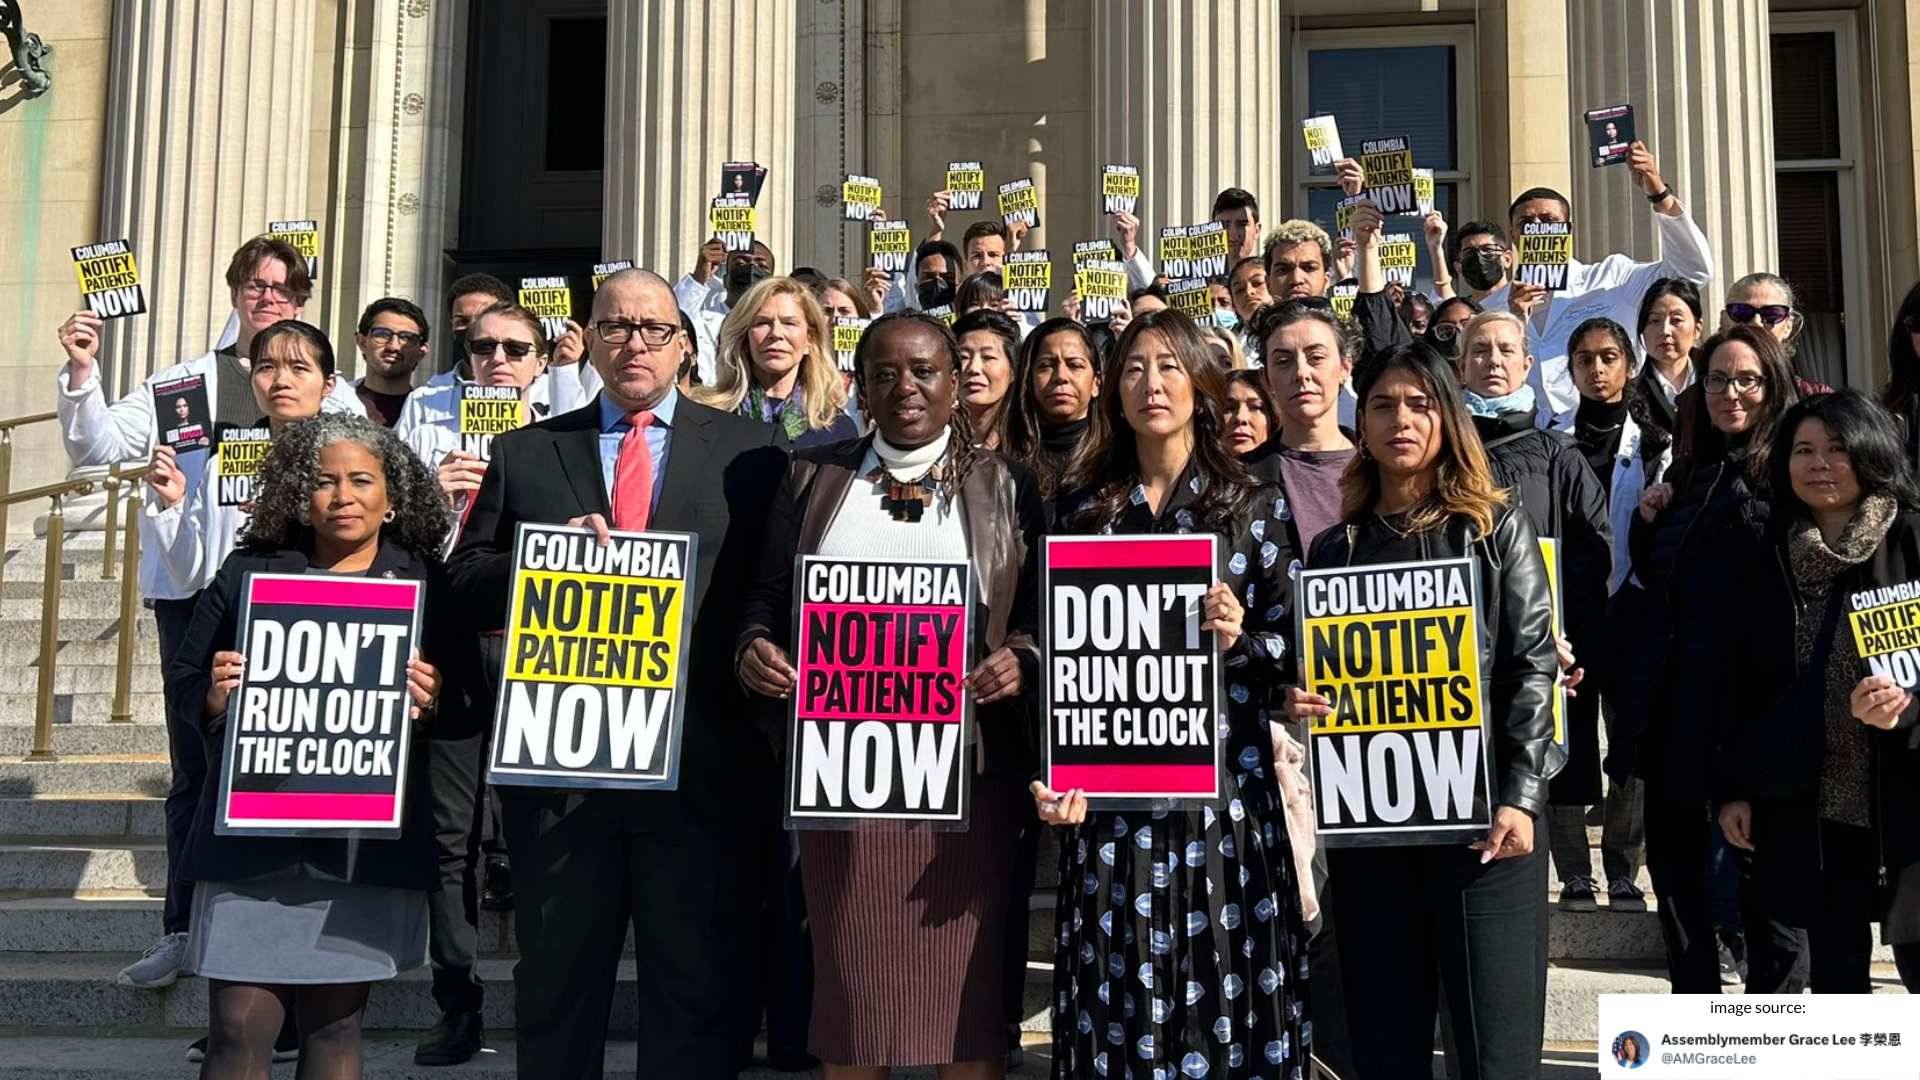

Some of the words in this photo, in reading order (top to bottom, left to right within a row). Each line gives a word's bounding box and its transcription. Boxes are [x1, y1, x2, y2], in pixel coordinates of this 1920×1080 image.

[1363, 138, 1405, 154] COLUMBIA
[949, 162, 981, 171] COLUMBIA
[1365, 153, 1406, 172] NOTIFY
[950, 172, 980, 182] NOTIFY
[1107, 175, 1136, 186] NOTIFY
[1368, 170, 1409, 185] PATIENTS
[848, 184, 878, 197] NOTIFY
[950, 183, 980, 191] PATIENTS
[1000, 179, 1032, 193] COLUMBIA
[1106, 186, 1136, 195] PATIENTS
[847, 194, 878, 204] PATIENTS
[950, 191, 980, 209] NOW
[1001, 188, 1032, 204] NOTIFY
[1106, 195, 1136, 213] NOW
[1369, 184, 1411, 213] NOW
[716, 209, 750, 221] NOTIFY
[1003, 200, 1035, 214] PATIENTS
[716, 221, 752, 230] PATIENTS
[1163, 228, 1187, 237] COLUM
[1189, 221, 1223, 236] COLUMBIA
[1524, 223, 1568, 235] COLUMBIA
[874, 231, 906, 242] NOTIFY
[1164, 238, 1187, 249] NOTI
[1190, 233, 1224, 249] NOTIFY
[1524, 236, 1567, 251] NOTIFY
[75, 240, 128, 260] COLUMBIA
[874, 242, 907, 252] PATIENTS
[1075, 240, 1112, 252] COLUMBIA
[1191, 244, 1226, 259] PATIENTS
[874, 252, 907, 271] NOW
[1010, 252, 1048, 263] COLUMBIA
[1381, 257, 1412, 267] ATIENTS
[1522, 251, 1566, 263] PATIENTS
[80, 255, 130, 278] NOTIFY
[1010, 264, 1047, 277] NOTIFY
[1191, 255, 1226, 278] NOW
[85, 272, 136, 291] PATIENTS
[522, 277, 565, 289] COLUMBIA
[1009, 278, 1047, 287] PATIENTS
[1087, 272, 1124, 286] NOTIFY
[1521, 264, 1566, 288] NOW
[1087, 285, 1123, 296] PATIENTS
[1168, 278, 1207, 293] COLUMBIA
[88, 285, 139, 318] NOW
[523, 290, 565, 305] NOTIFY
[1008, 289, 1046, 310] NOW
[1169, 290, 1207, 308] NOTIFY
[539, 317, 568, 341] OW
[838, 351, 856, 371] NO
[465, 386, 518, 400] COLUMBIA
[466, 402, 518, 418] NOTIFY
[223, 428, 271, 441] COLUMBIA
[465, 433, 495, 461] NO
[524, 532, 682, 579] COLUMBIA
[808, 563, 962, 605] COLUMBIA
[1307, 567, 1469, 617] COLUMBIA
[520, 577, 677, 637] NOTIFY
[1054, 584, 1208, 650] DON'T
[807, 611, 959, 668] NOTIFY
[1312, 614, 1466, 680] NOTIFY
[248, 619, 408, 686] DON'T
[514, 633, 671, 682] PATIENTS
[1868, 648, 1920, 688] NO
[1054, 656, 1128, 702] RUN
[1136, 655, 1208, 702] OUT
[805, 669, 957, 715] PATIENTS
[1315, 675, 1473, 728] PATIENTS
[241, 687, 319, 733] RUN
[324, 688, 401, 734] OUT
[501, 681, 672, 770] NOW
[1053, 708, 1108, 746] THE
[1113, 707, 1210, 746] CLOCK
[238, 737, 294, 775] THE
[296, 738, 395, 777] CLOCK
[800, 720, 960, 810] NOW
[1317, 728, 1480, 824] NOW
